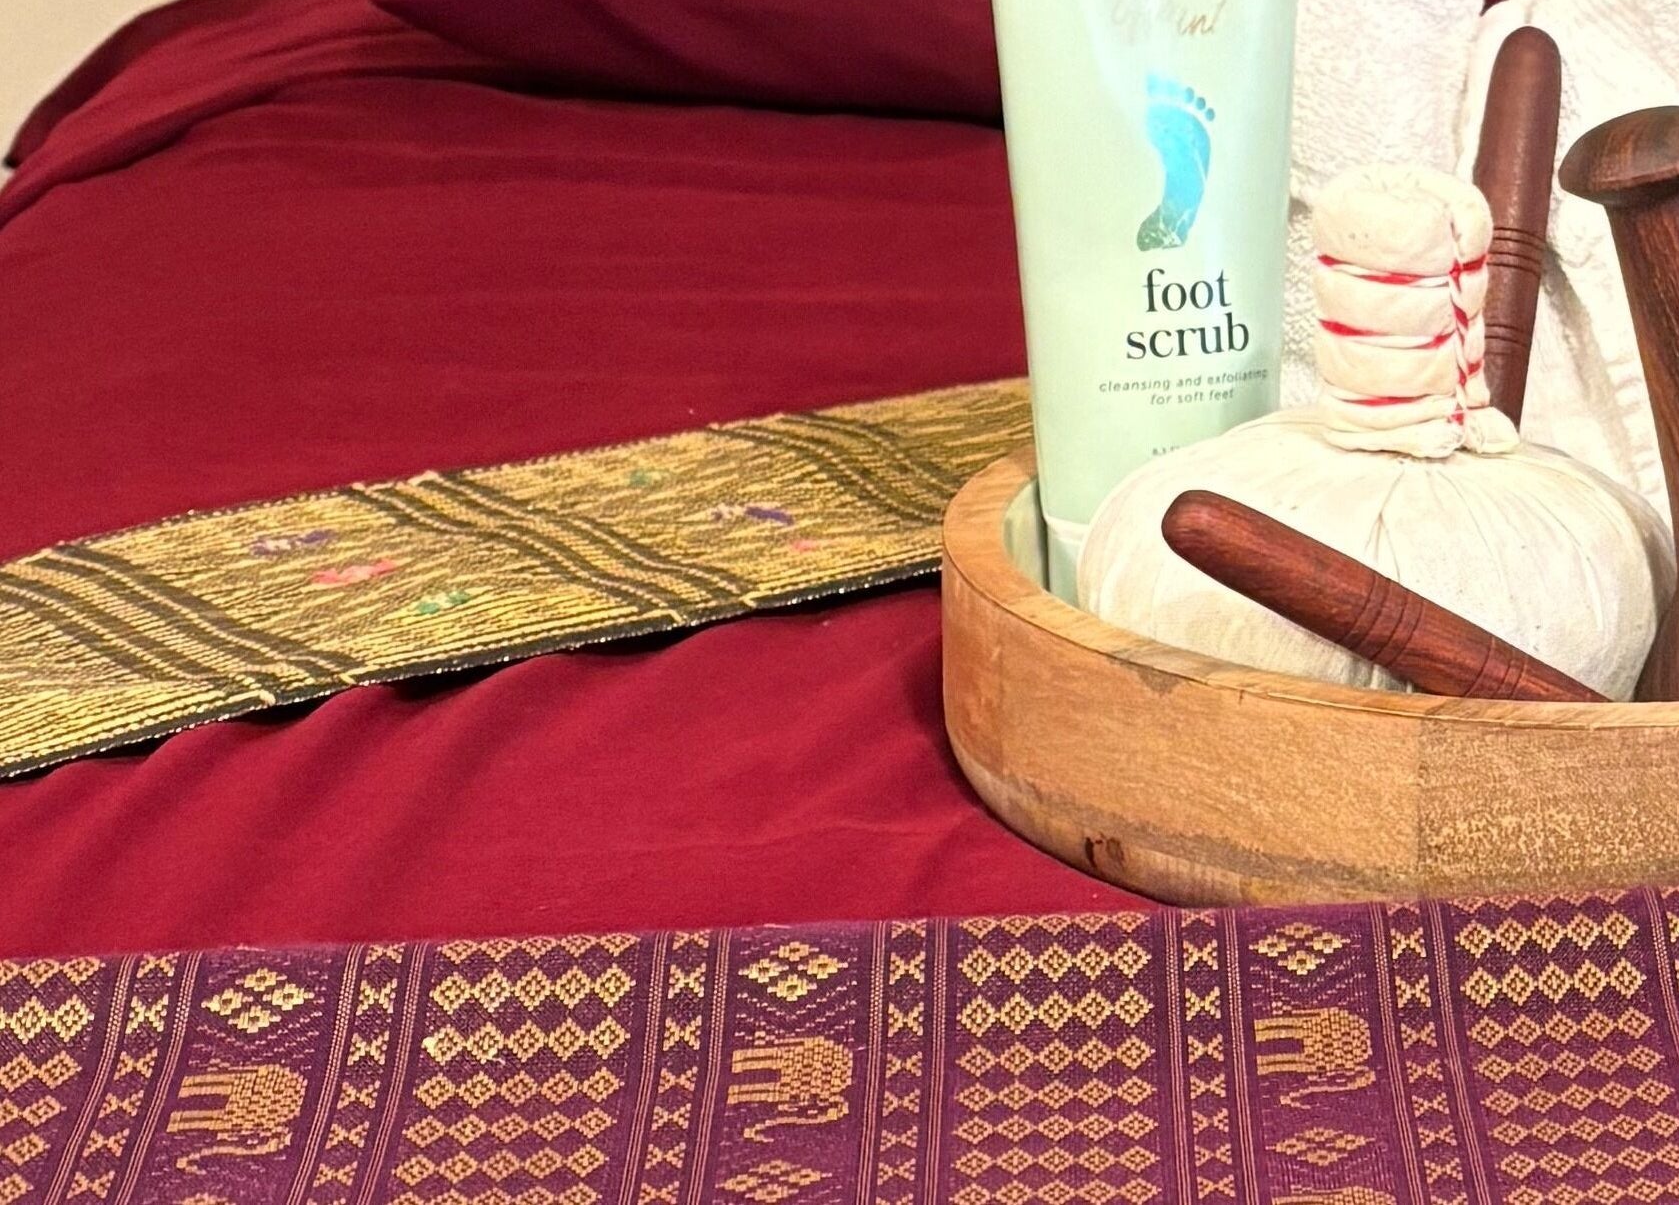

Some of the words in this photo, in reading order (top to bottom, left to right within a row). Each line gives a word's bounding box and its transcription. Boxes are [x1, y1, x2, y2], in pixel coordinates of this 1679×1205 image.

[1142, 268, 1232, 313] foot
[1126, 312, 1250, 360] scrub
[1099, 379, 1171, 393] cleansing
[1176, 375, 1202, 388] and
[1206, 368, 1269, 385] exfoliating
[1150, 393, 1172, 406] for
[1177, 391, 1204, 404] soft
[1209, 388, 1235, 401] feet
